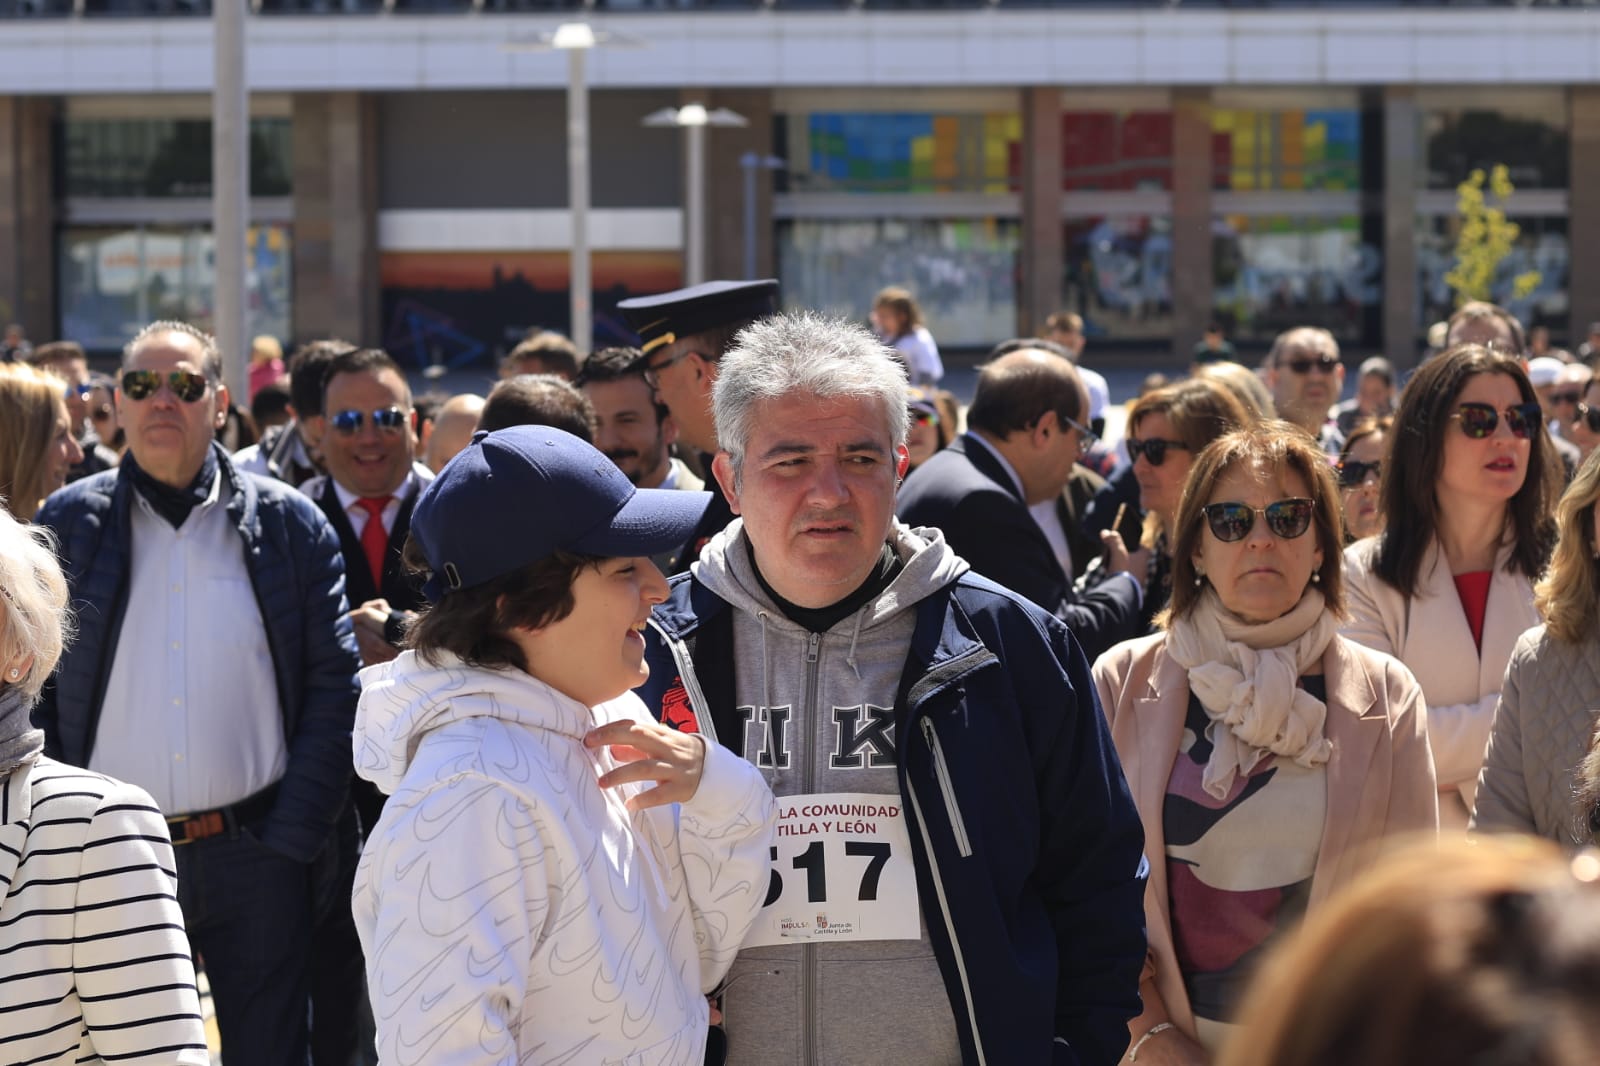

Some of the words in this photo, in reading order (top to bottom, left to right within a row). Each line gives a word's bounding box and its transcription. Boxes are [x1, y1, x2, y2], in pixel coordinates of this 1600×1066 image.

[780, 808, 798, 819] LA
[802, 804, 899, 817] COMUNIDAD
[822, 822, 832, 833] Y
[836, 820, 876, 834] LEÓN
